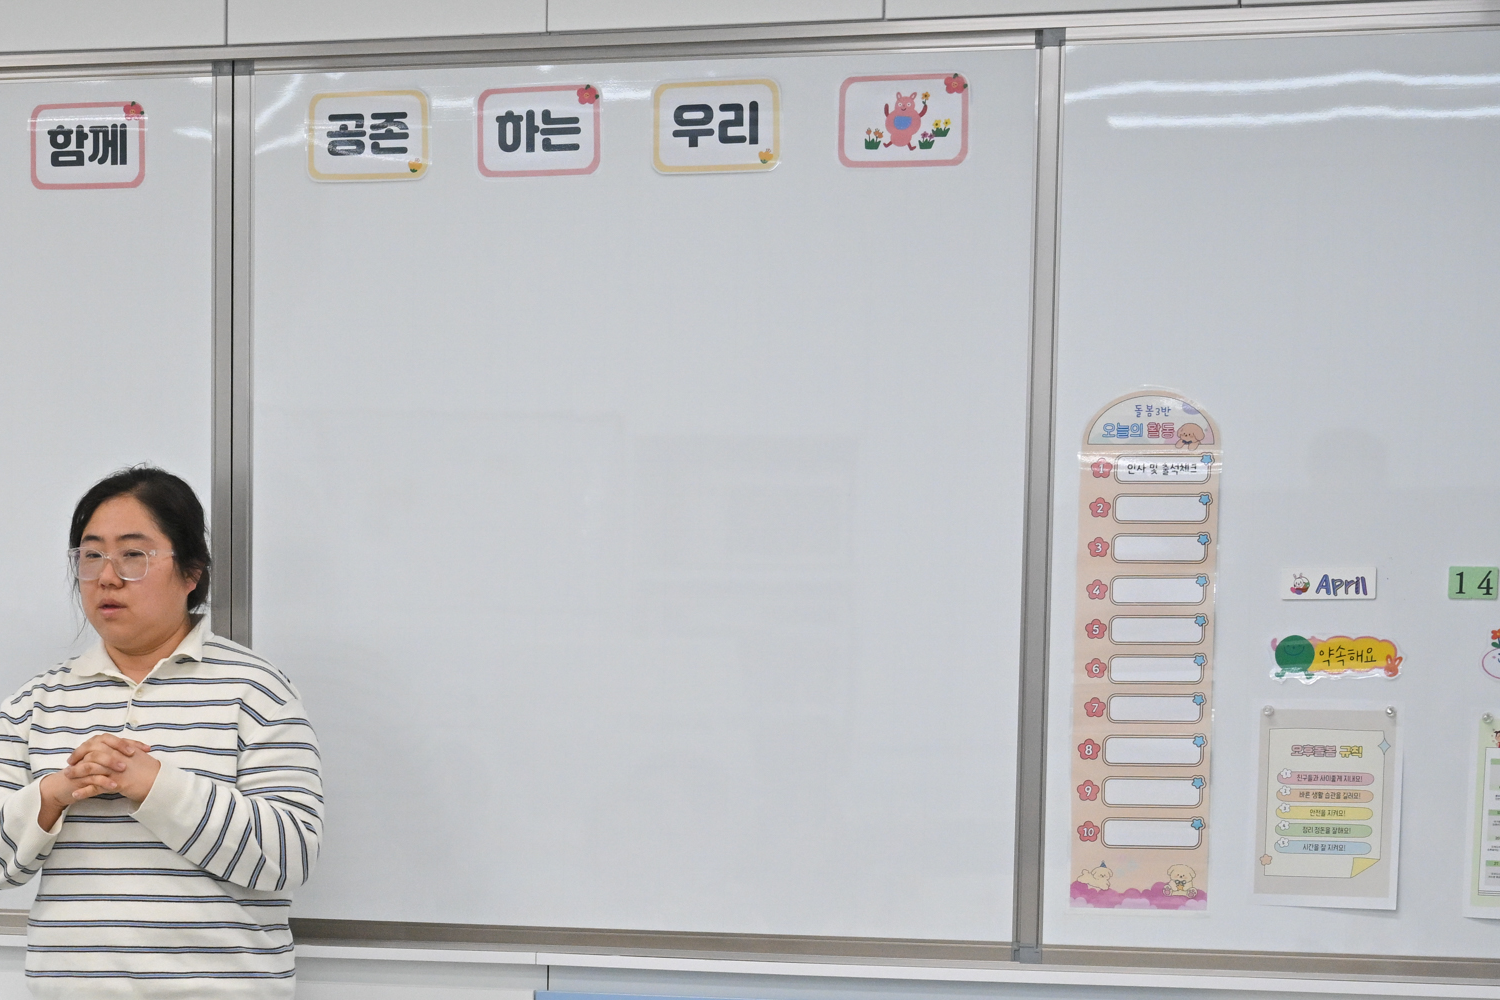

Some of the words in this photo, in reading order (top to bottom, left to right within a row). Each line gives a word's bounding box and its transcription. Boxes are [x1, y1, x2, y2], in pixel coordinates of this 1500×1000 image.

[48, 124, 128, 167] 함께
[326, 112, 410, 157] 공존
[495, 109, 582, 153] 하는
[672, 100, 759, 149] 우리
[1102, 422, 1144, 439] 오늘의
[1147, 421, 1175, 439] 활동
[1099, 463, 1104, 474] 1
[1127, 464, 1146, 475] 인사
[1149, 464, 1158, 475] 및
[1162, 463, 1197, 476] 출석체크
[1097, 503, 1104, 513] 2
[1095, 543, 1102, 553] 3
[1315, 574, 1368, 596] April
[1093, 586, 1100, 595] 4
[1093, 625, 1099, 634] 5
[1319, 645, 1377, 667] 약속해요
[1092, 664, 1100, 674] 6
[1092, 703, 1099, 713] 7
[1085, 744, 1092, 755] 8
[1291, 744, 1336, 757] 오후돌봄
[1339, 745, 1363, 758] 규칙
[1085, 786, 1092, 797] 9
[1309, 809, 1326, 817] 안전을
[1083, 828, 1095, 837] 10
